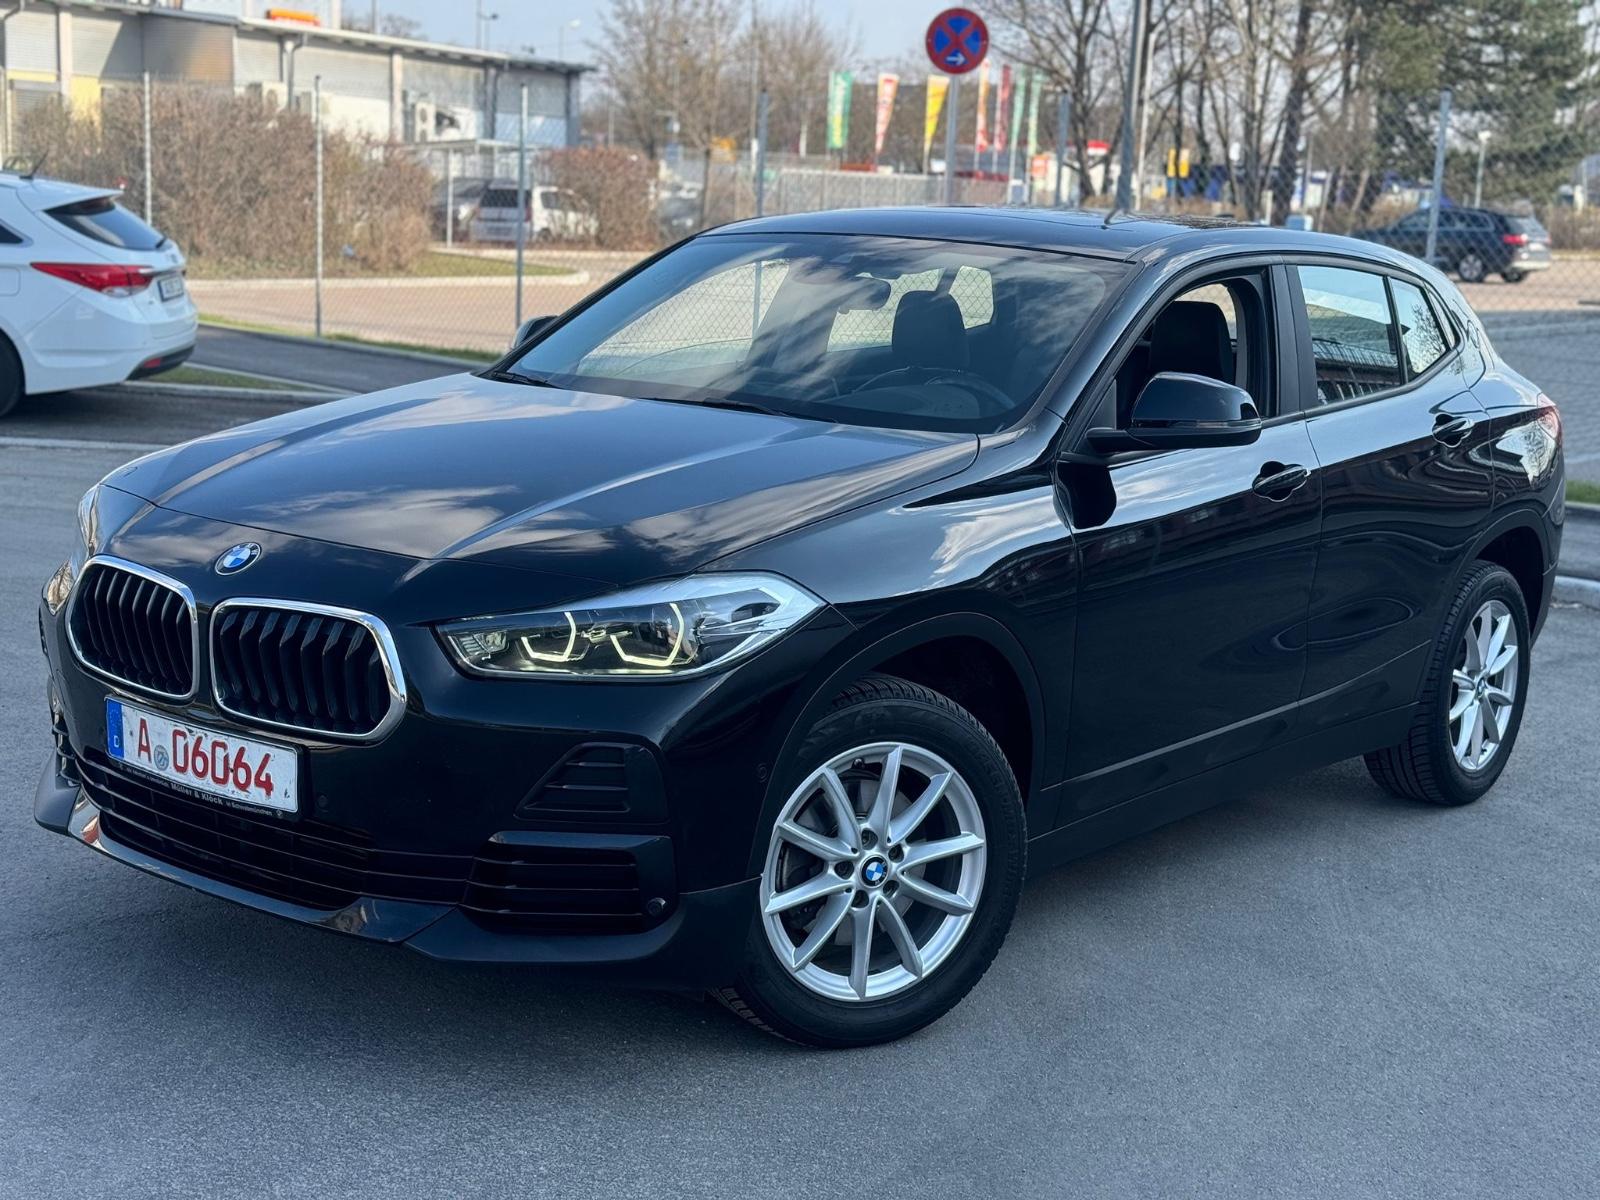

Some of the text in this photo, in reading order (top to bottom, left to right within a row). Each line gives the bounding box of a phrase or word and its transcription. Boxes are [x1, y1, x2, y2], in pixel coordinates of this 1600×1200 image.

[113, 735, 120, 748] D
[138, 717, 274, 797] A 06064
[170, 783, 192, 796] Müller
[194, 790, 200, 799] &
